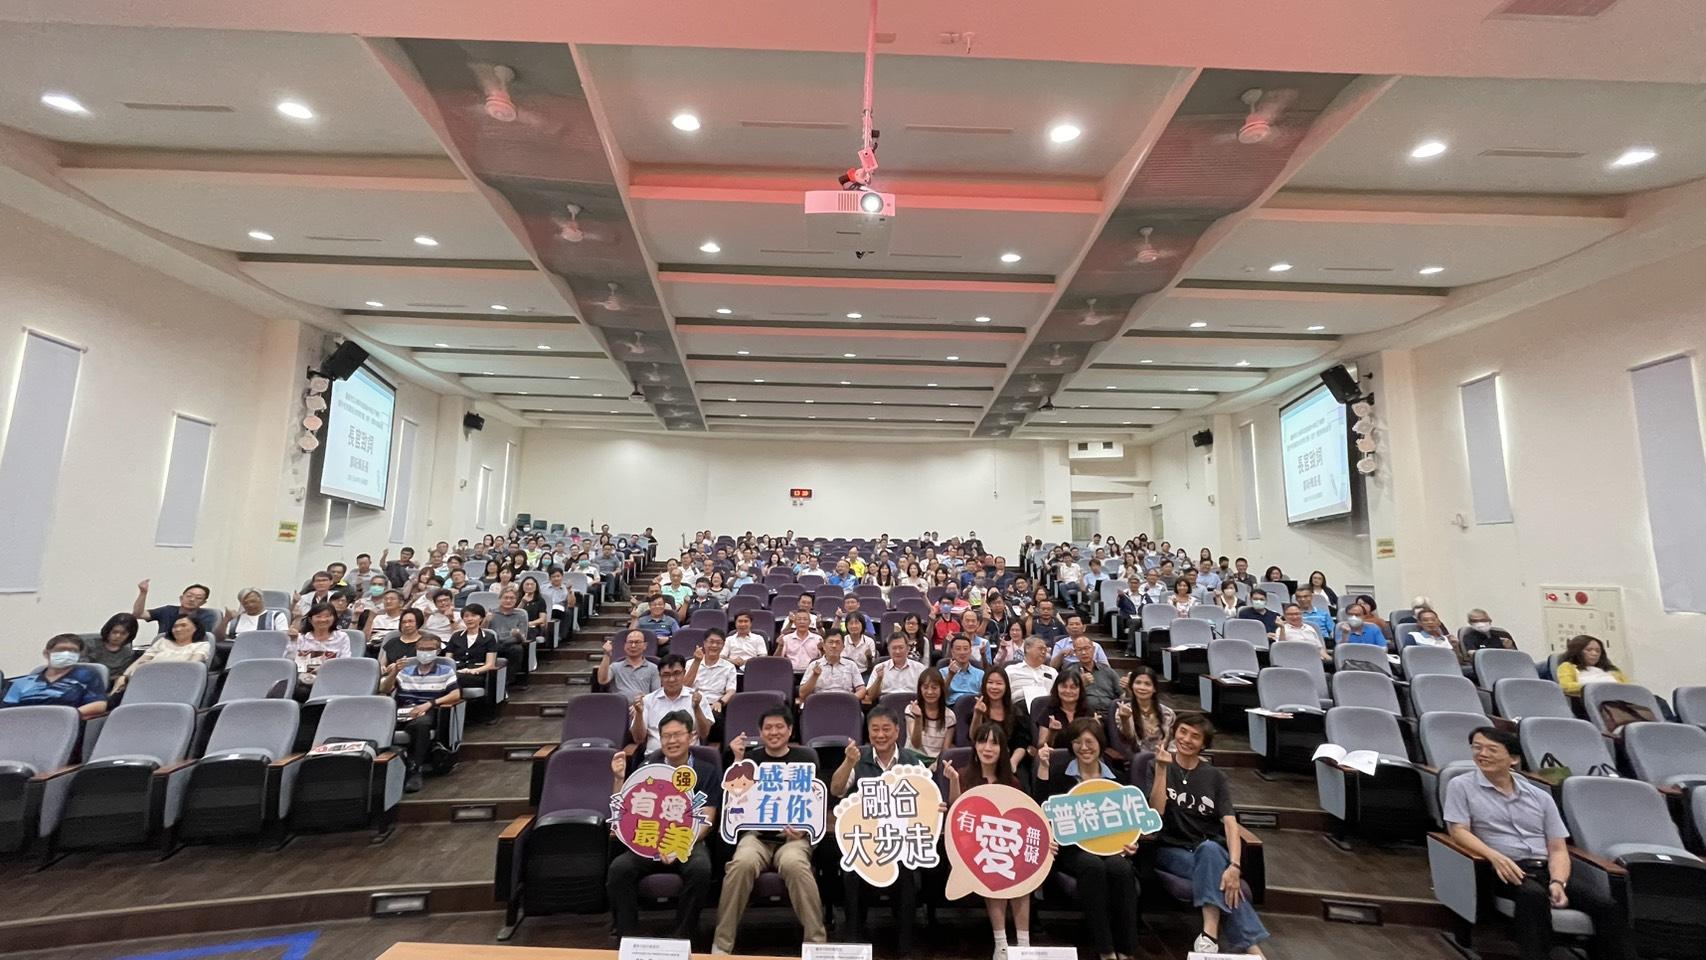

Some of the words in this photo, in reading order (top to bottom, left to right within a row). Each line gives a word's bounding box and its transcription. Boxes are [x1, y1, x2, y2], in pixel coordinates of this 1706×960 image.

[757, 765, 814, 792] 感謝
[631, 789, 688, 823] 有愛
[756, 794, 813, 823] 有你
[861, 779, 918, 818] 融合
[634, 819, 695, 863] 最美
[843, 822, 937, 866] 大步走
[974, 814, 1024, 880] 愛
